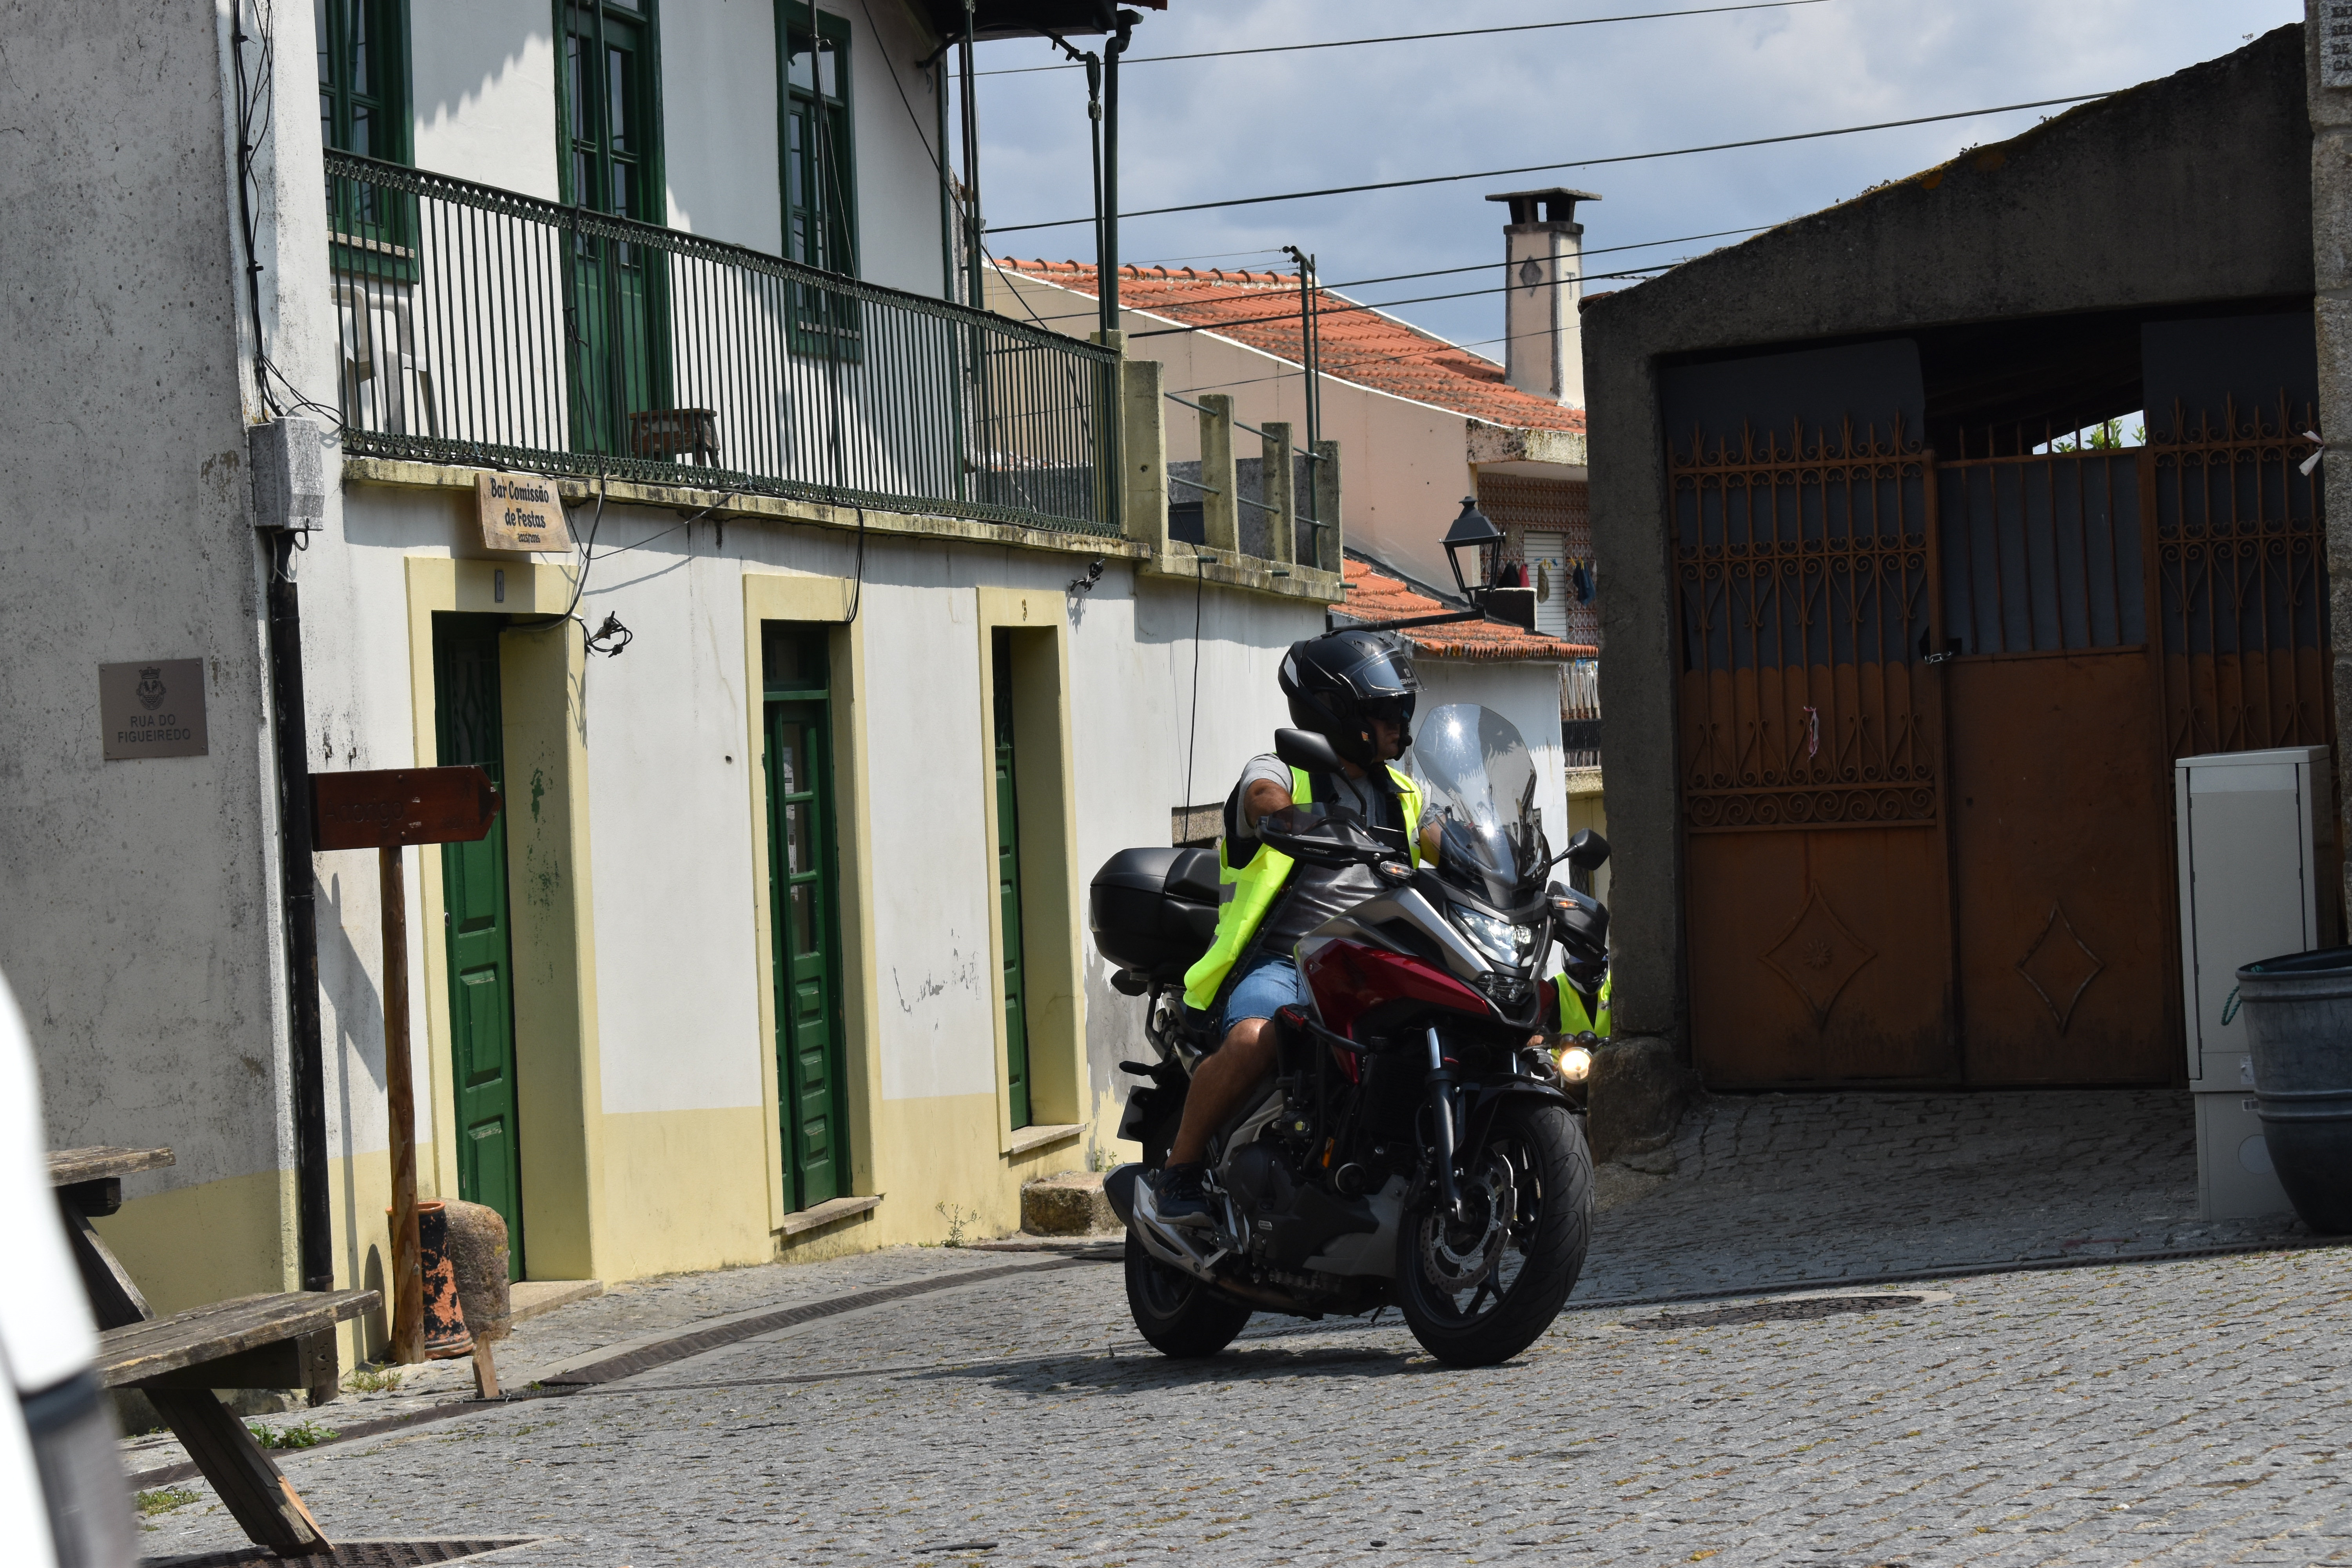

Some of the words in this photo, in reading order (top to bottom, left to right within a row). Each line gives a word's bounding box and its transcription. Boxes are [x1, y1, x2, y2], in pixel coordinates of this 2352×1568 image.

[2333, 43, 2350, 55] DE
[490, 478, 507, 498] Bar
[508, 481, 549, 503] Comissão
[505, 507, 516, 526] de
[516, 508, 546, 528] Festas
[1022, 599, 1027, 618] 3
[131, 715, 155, 728] RUA
[159, 714, 176, 726] DO
[118, 728, 191, 743] FIGUEIREDO
